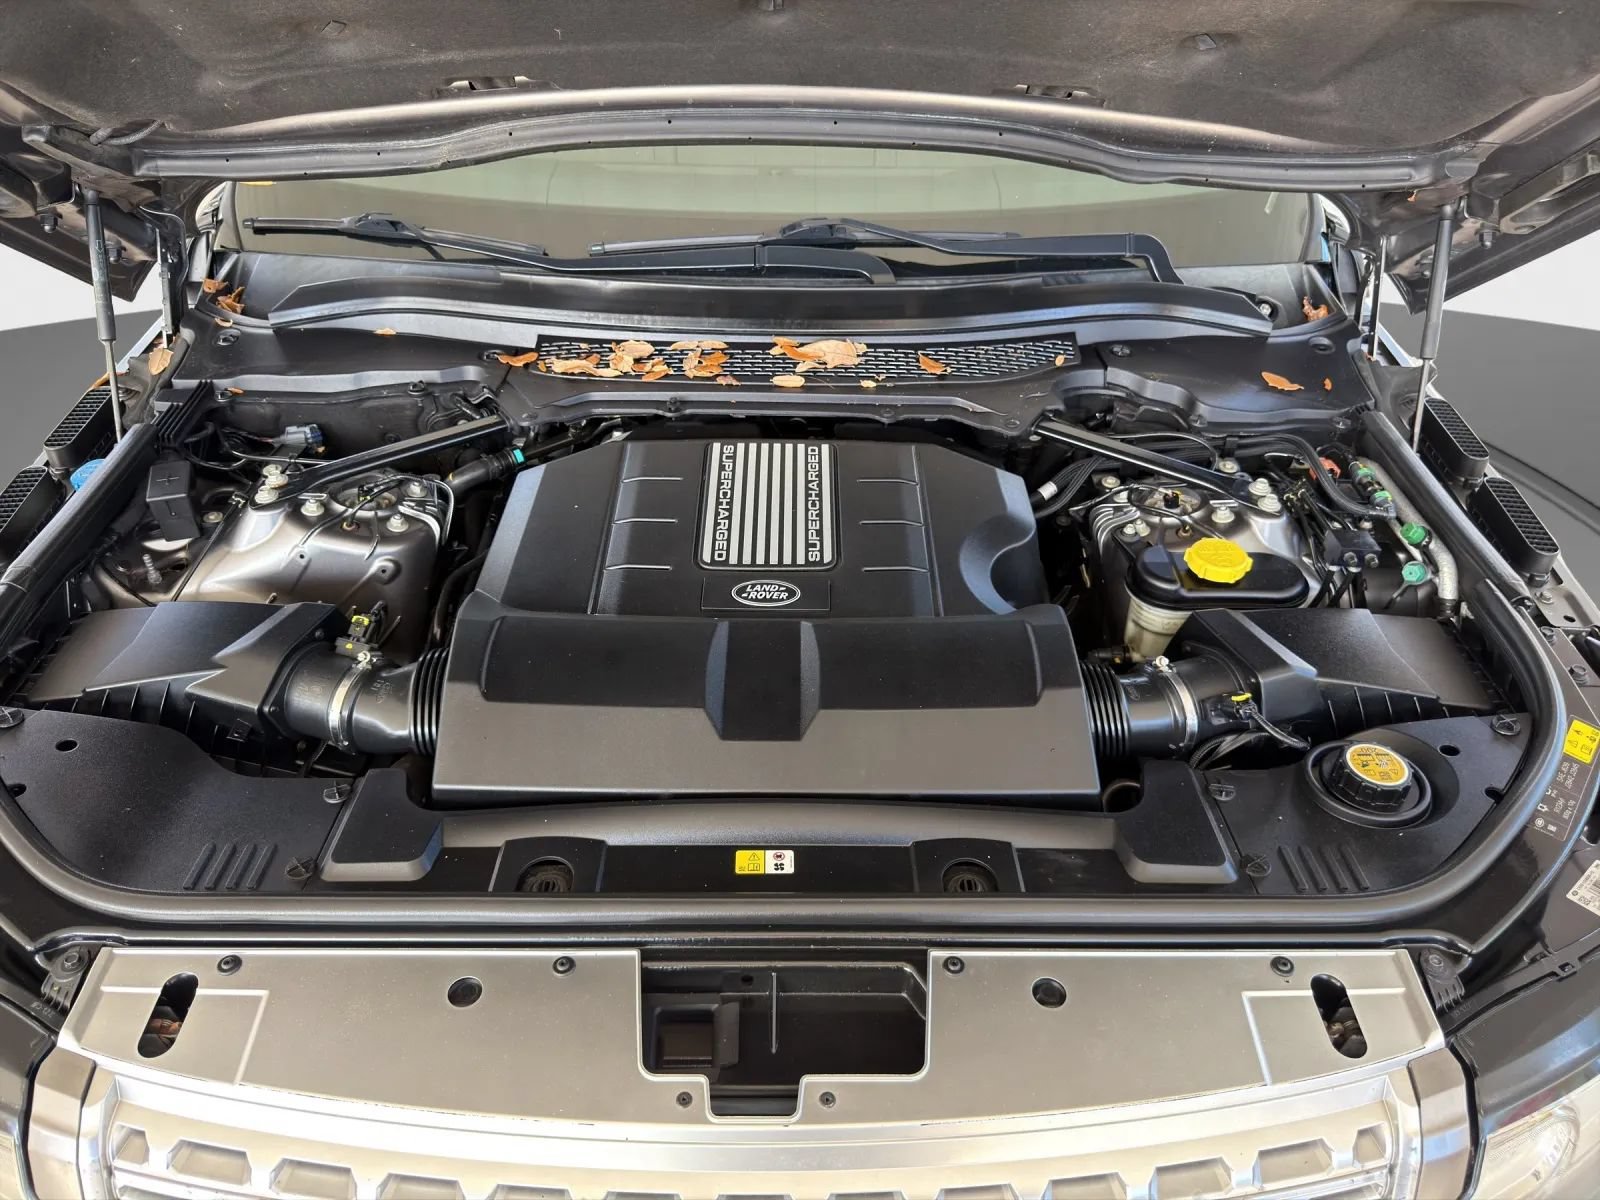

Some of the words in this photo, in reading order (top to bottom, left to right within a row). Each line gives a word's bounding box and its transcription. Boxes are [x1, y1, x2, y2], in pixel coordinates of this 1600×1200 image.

[714, 444, 735, 562] SUPERCHARGED
[807, 445, 821, 562] SUPERCHARGED
[745, 584, 779, 592] LAND
[748, 591, 789, 600] ROVER
